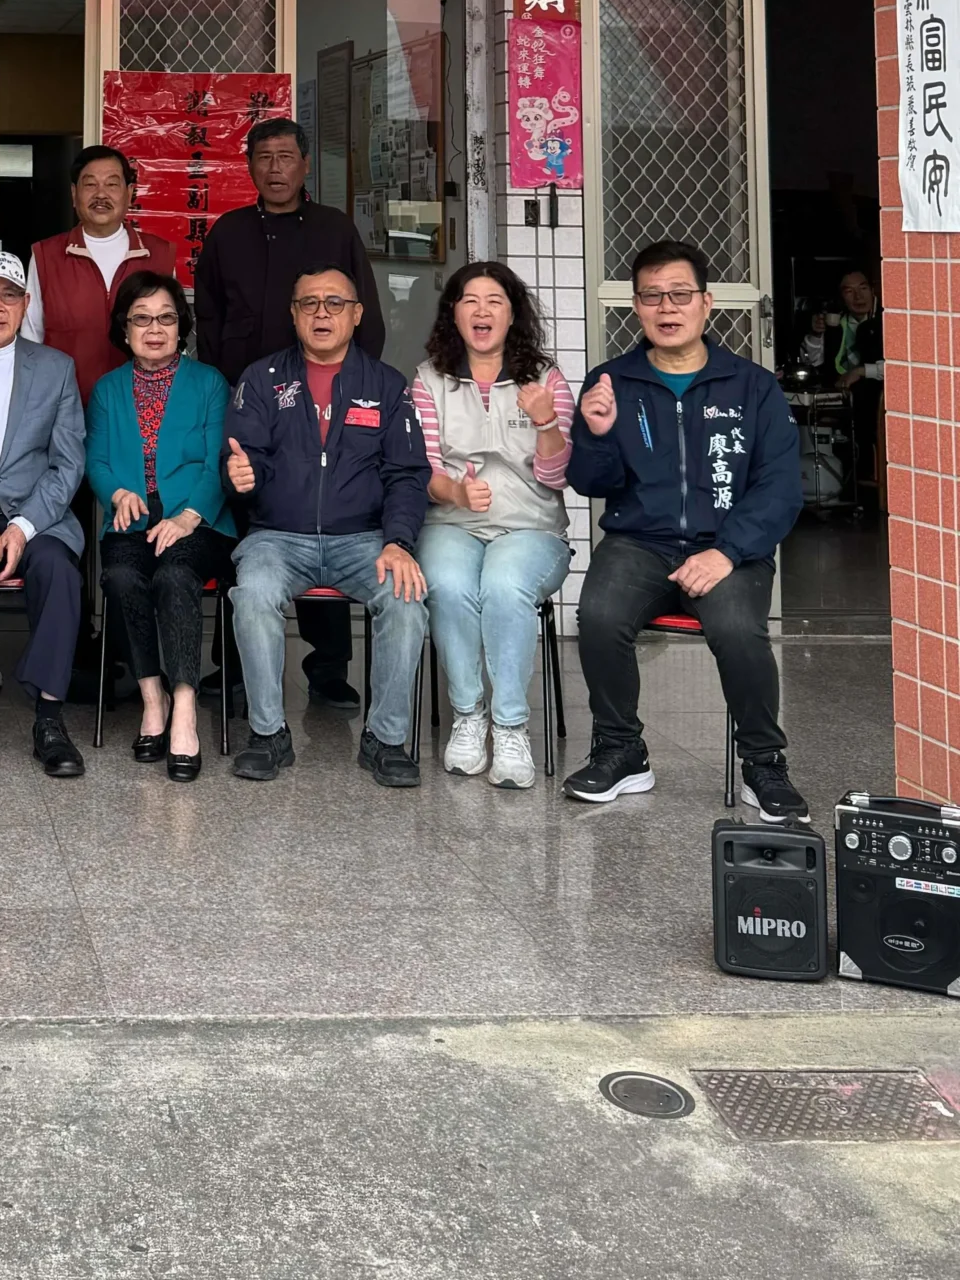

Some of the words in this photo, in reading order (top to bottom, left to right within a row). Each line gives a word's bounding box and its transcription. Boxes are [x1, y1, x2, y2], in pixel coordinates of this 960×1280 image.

[516, 36, 532, 89] 蛇來運轉
[730, 426, 747, 455] 代表
[707, 433, 733, 510] 廖高源
